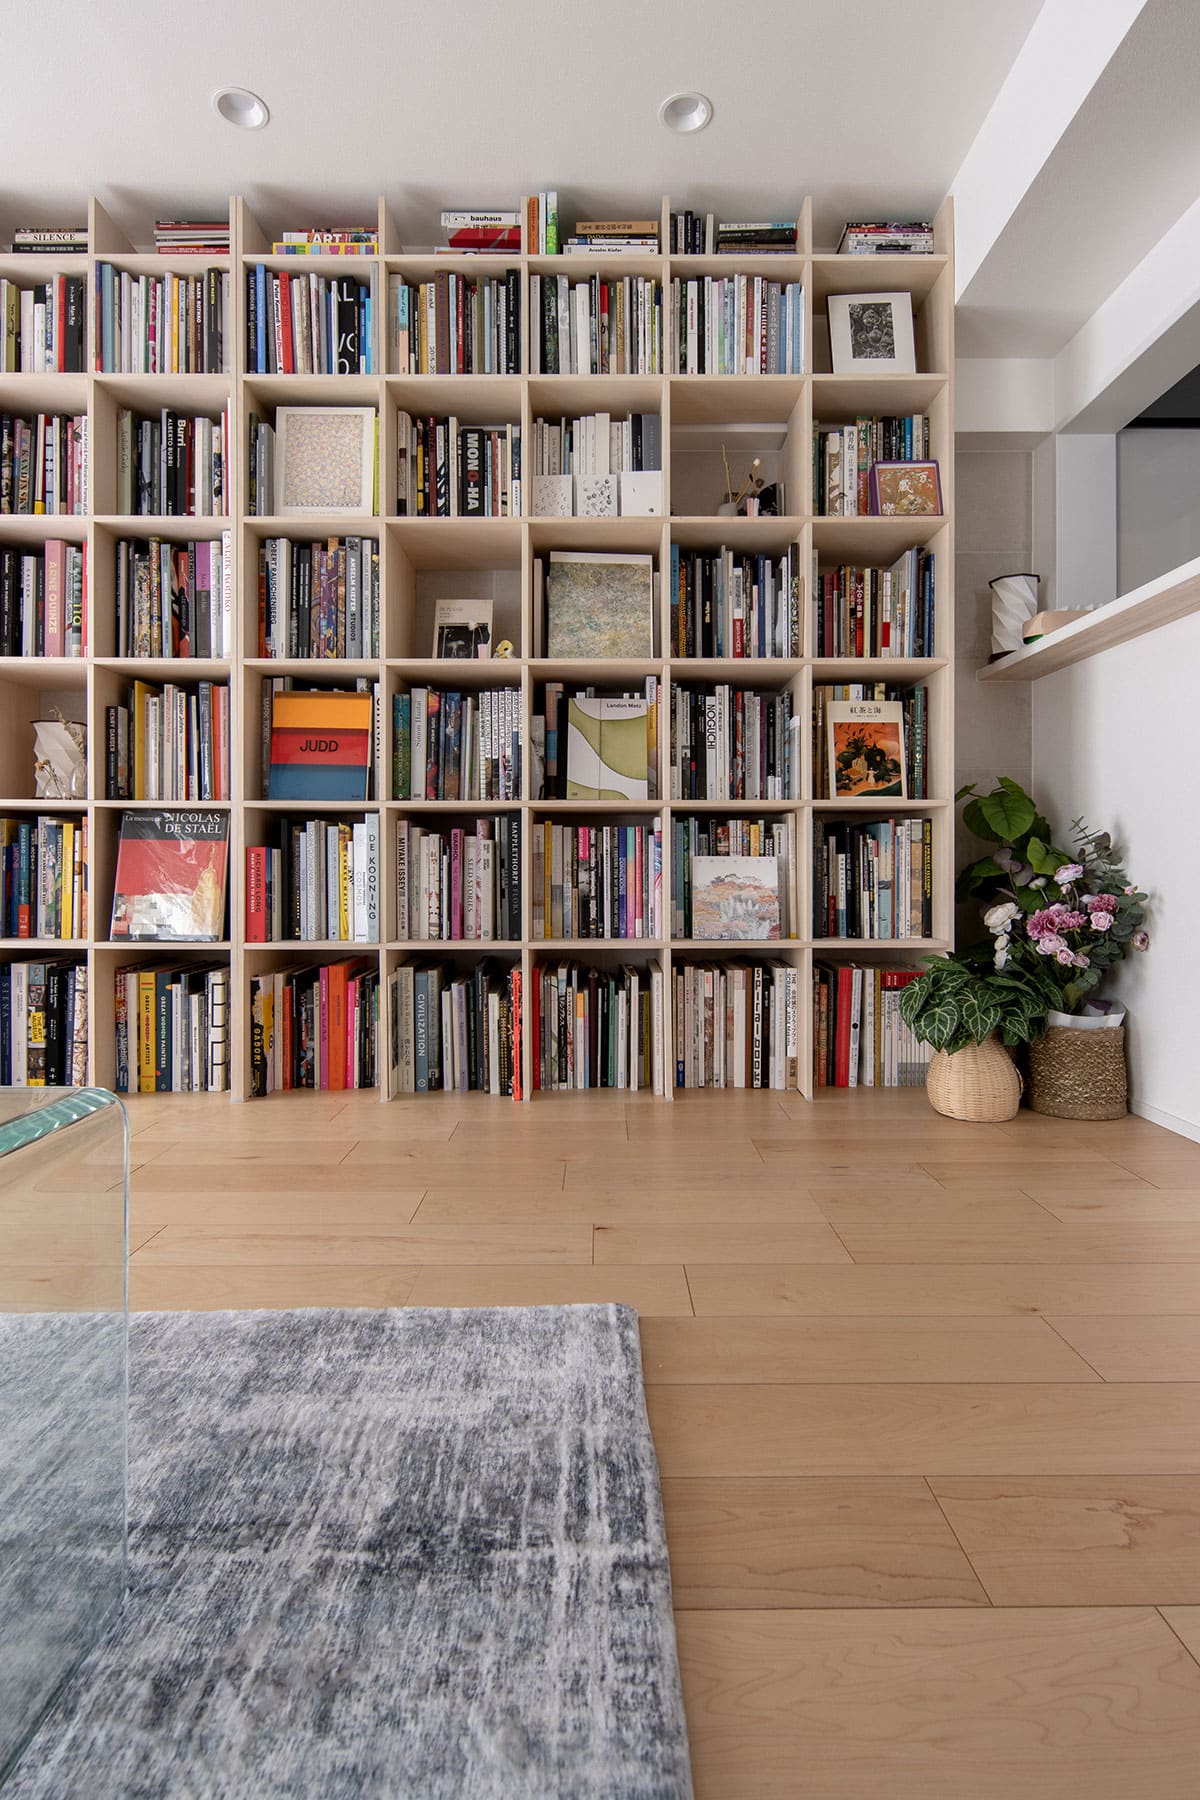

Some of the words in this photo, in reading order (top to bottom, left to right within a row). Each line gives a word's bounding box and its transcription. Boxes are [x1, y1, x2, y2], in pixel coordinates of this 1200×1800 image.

[33, 233, 76, 242] SILENCE
[311, 233, 342, 243] ART
[177, 419, 187, 447] Burri
[20, 449, 30, 513] KANDINSKY
[466, 432, 479, 511] MONO-HA
[224, 543, 232, 570] Mark
[270, 538, 278, 566] ROBERT
[48, 561, 58, 592] ARNE
[270, 567, 278, 625] RAUSCHENBERG
[48, 593, 58, 635] QUINZE
[706, 704, 717, 750] NOGUCHI
[300, 739, 339, 753] JUDD
[164, 812, 221, 823] NICOLAS
[164, 823, 181, 833] DE
[184, 821, 222, 834] STAËL
[369, 834, 377, 852] DE
[397, 837, 406, 867] MIYAKE
[511, 821, 520, 886] MAPPLETHORPE
[255, 852, 263, 889] RICHARD
[466, 858, 475, 878] SEED
[255, 891, 263, 913] LONG
[355, 871, 363, 907] COSMOS
[368, 856, 377, 920] KOONING
[466, 878, 475, 913] STORIES
[511, 887, 519, 915] FLORA
[1, 981, 9, 1018] SIENA
[31, 1015, 39, 1041] MUSEUM
[417, 993, 426, 1058] CIVILIZATION
